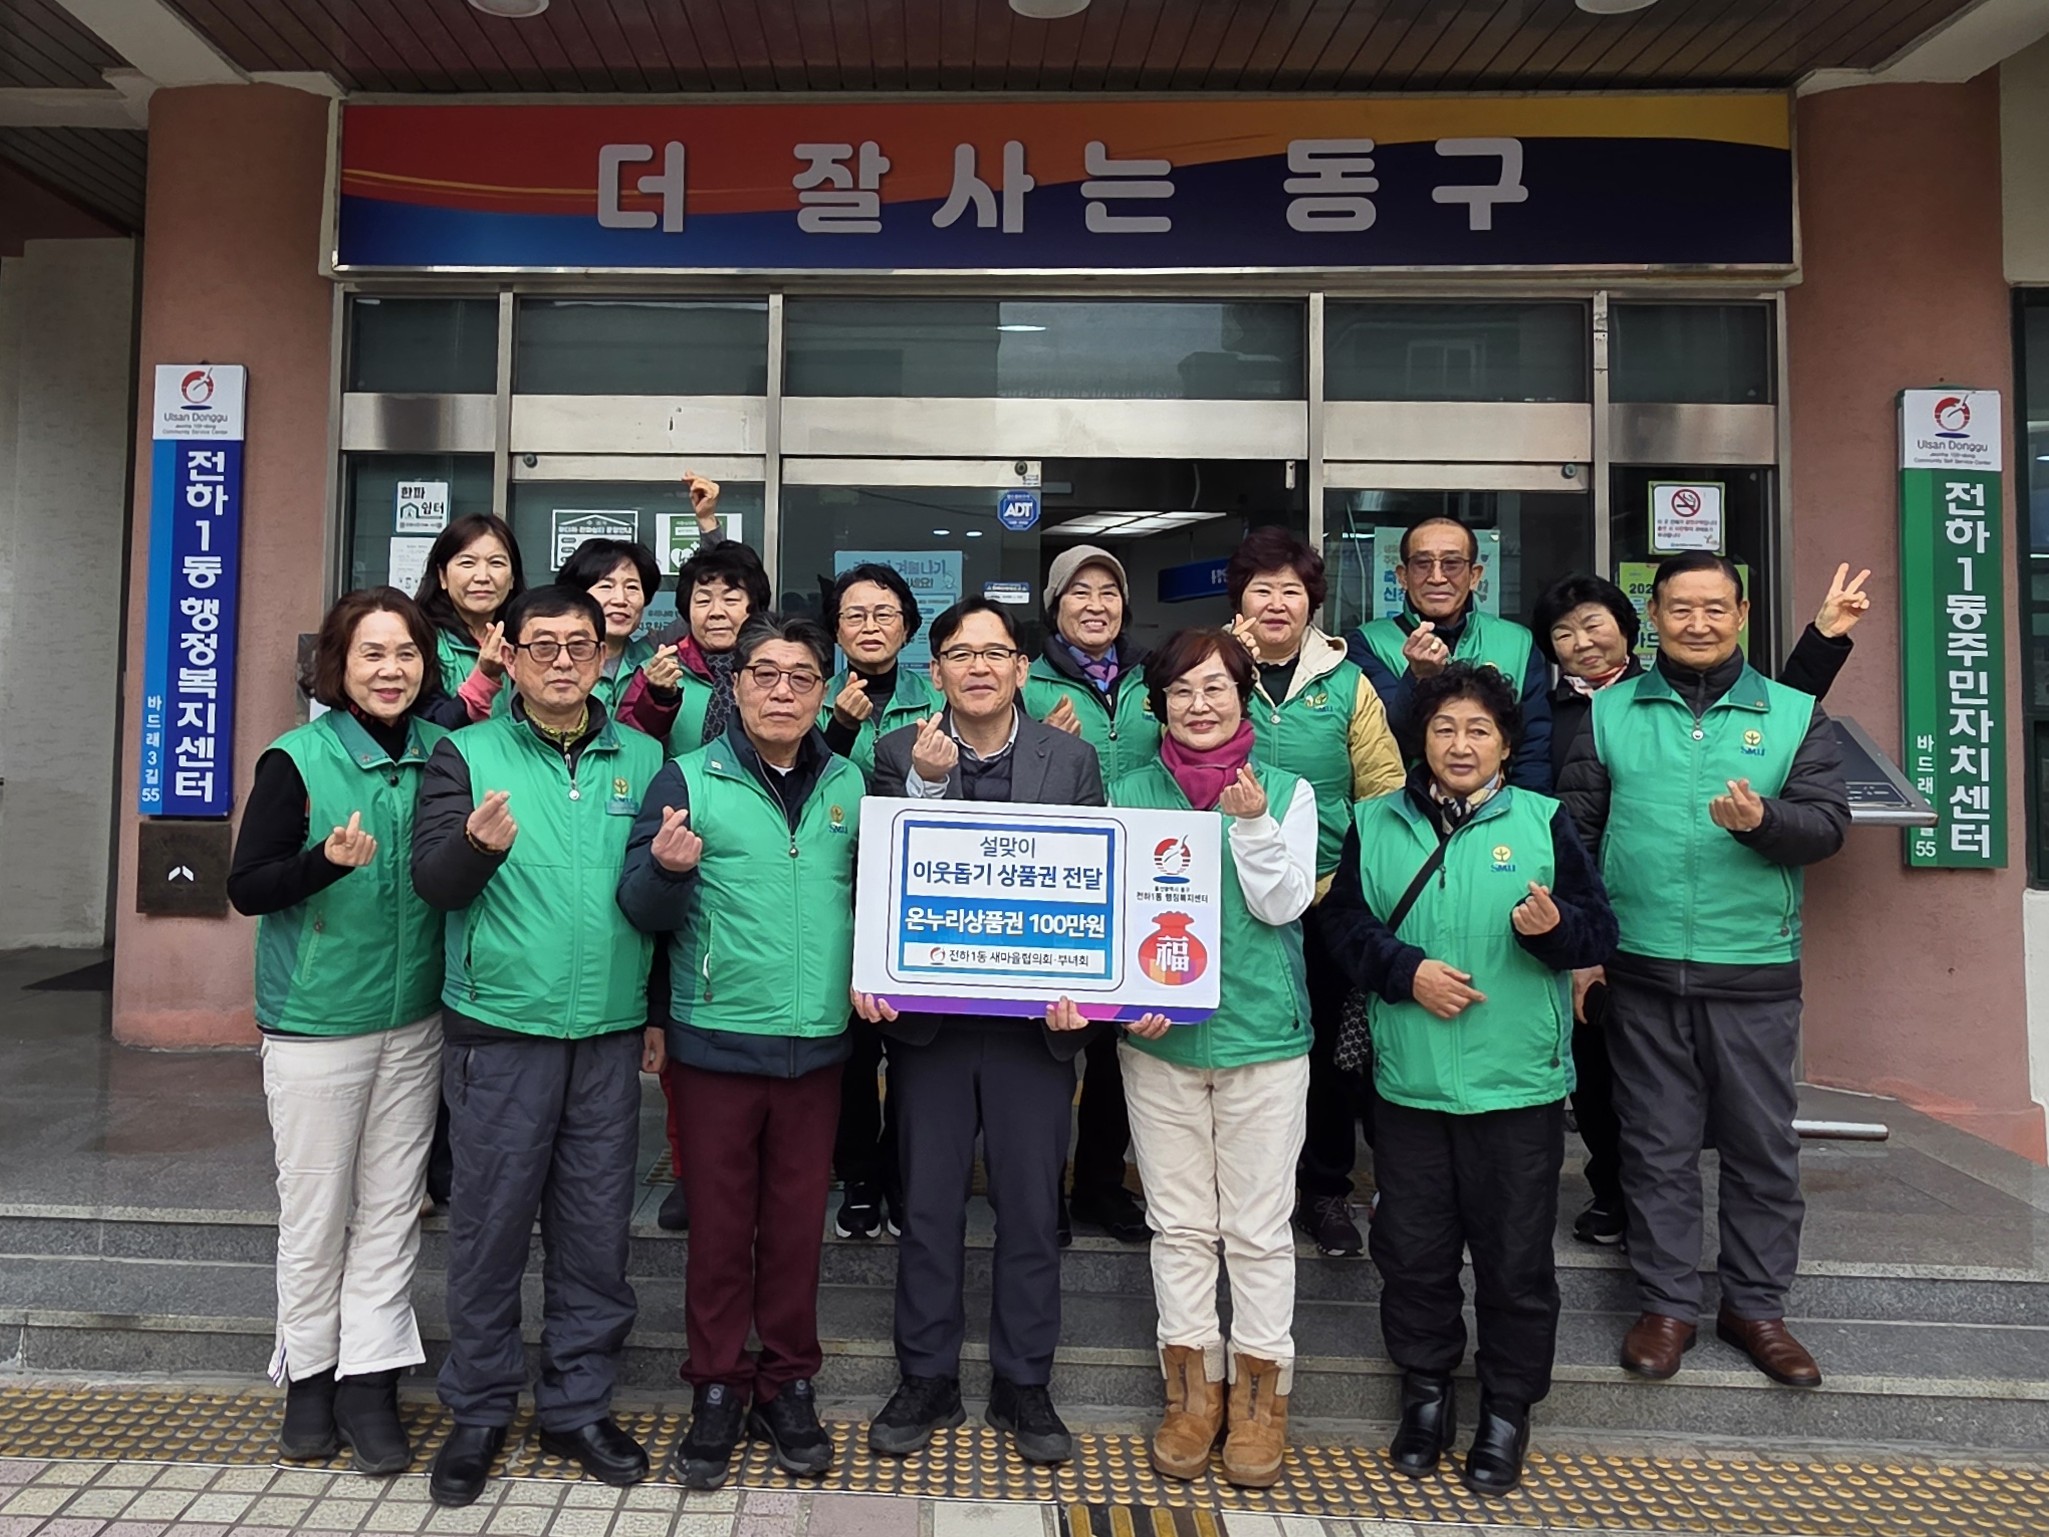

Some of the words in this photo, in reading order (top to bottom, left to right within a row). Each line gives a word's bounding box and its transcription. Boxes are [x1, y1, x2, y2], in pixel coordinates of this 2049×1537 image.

[597, 140, 686, 233] 더
[1282, 136, 1530, 233] 동구
[164, 412, 190, 422] Ulsan
[192, 412, 228, 423] Donggu
[1917, 439, 1946, 450] Ulsan
[1948, 440, 1988, 452] Donggu
[401, 486, 426, 499] 한파
[1003, 502, 1033, 517] ADT
[1629, 583, 1653, 594] 202
[980, 836, 1036, 858] 설맞이
[913, 861, 992, 886] 이웃돕기
[997, 864, 1057, 888] 상품권
[1062, 866, 1103, 890] 전달
[1137, 891, 1162, 901] 전하1동
[1165, 893, 1209, 903] 행정복지센터
[905, 907, 1023, 935] 온누리상품권
[1029, 913, 1105, 938] 100만원
[949, 950, 987, 963] 전하1동
[1155, 935, 1189, 972] 福
